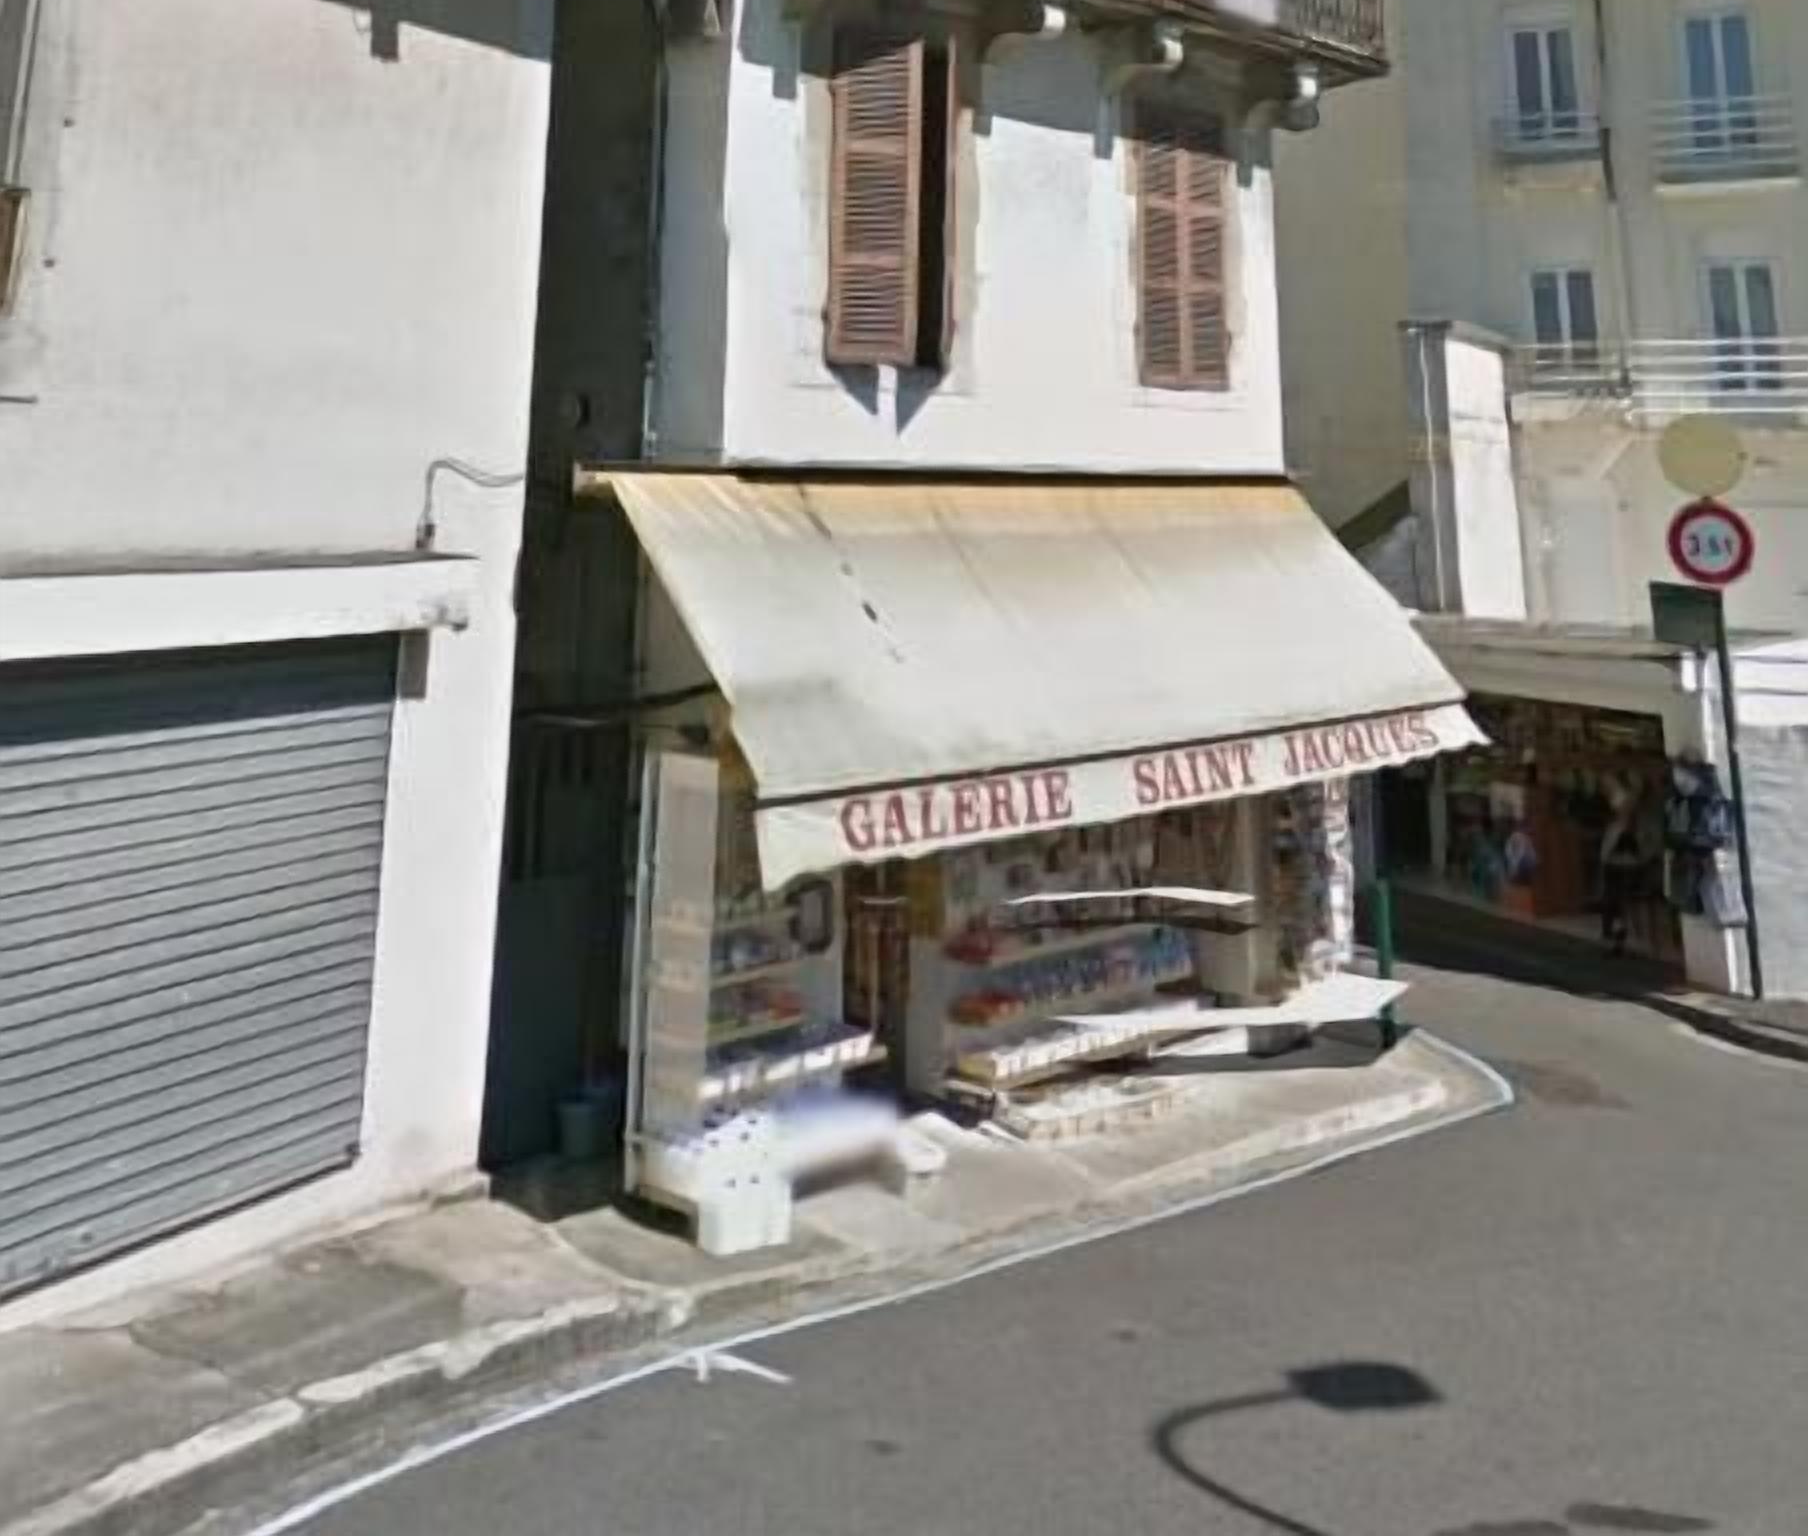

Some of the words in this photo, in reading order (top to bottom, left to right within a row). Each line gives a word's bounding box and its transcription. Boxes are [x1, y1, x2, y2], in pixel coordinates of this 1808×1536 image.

[840, 770, 1073, 852] GALERIE
[1132, 741, 1254, 804] SAINT
[1284, 713, 1439, 776] JACQUES
